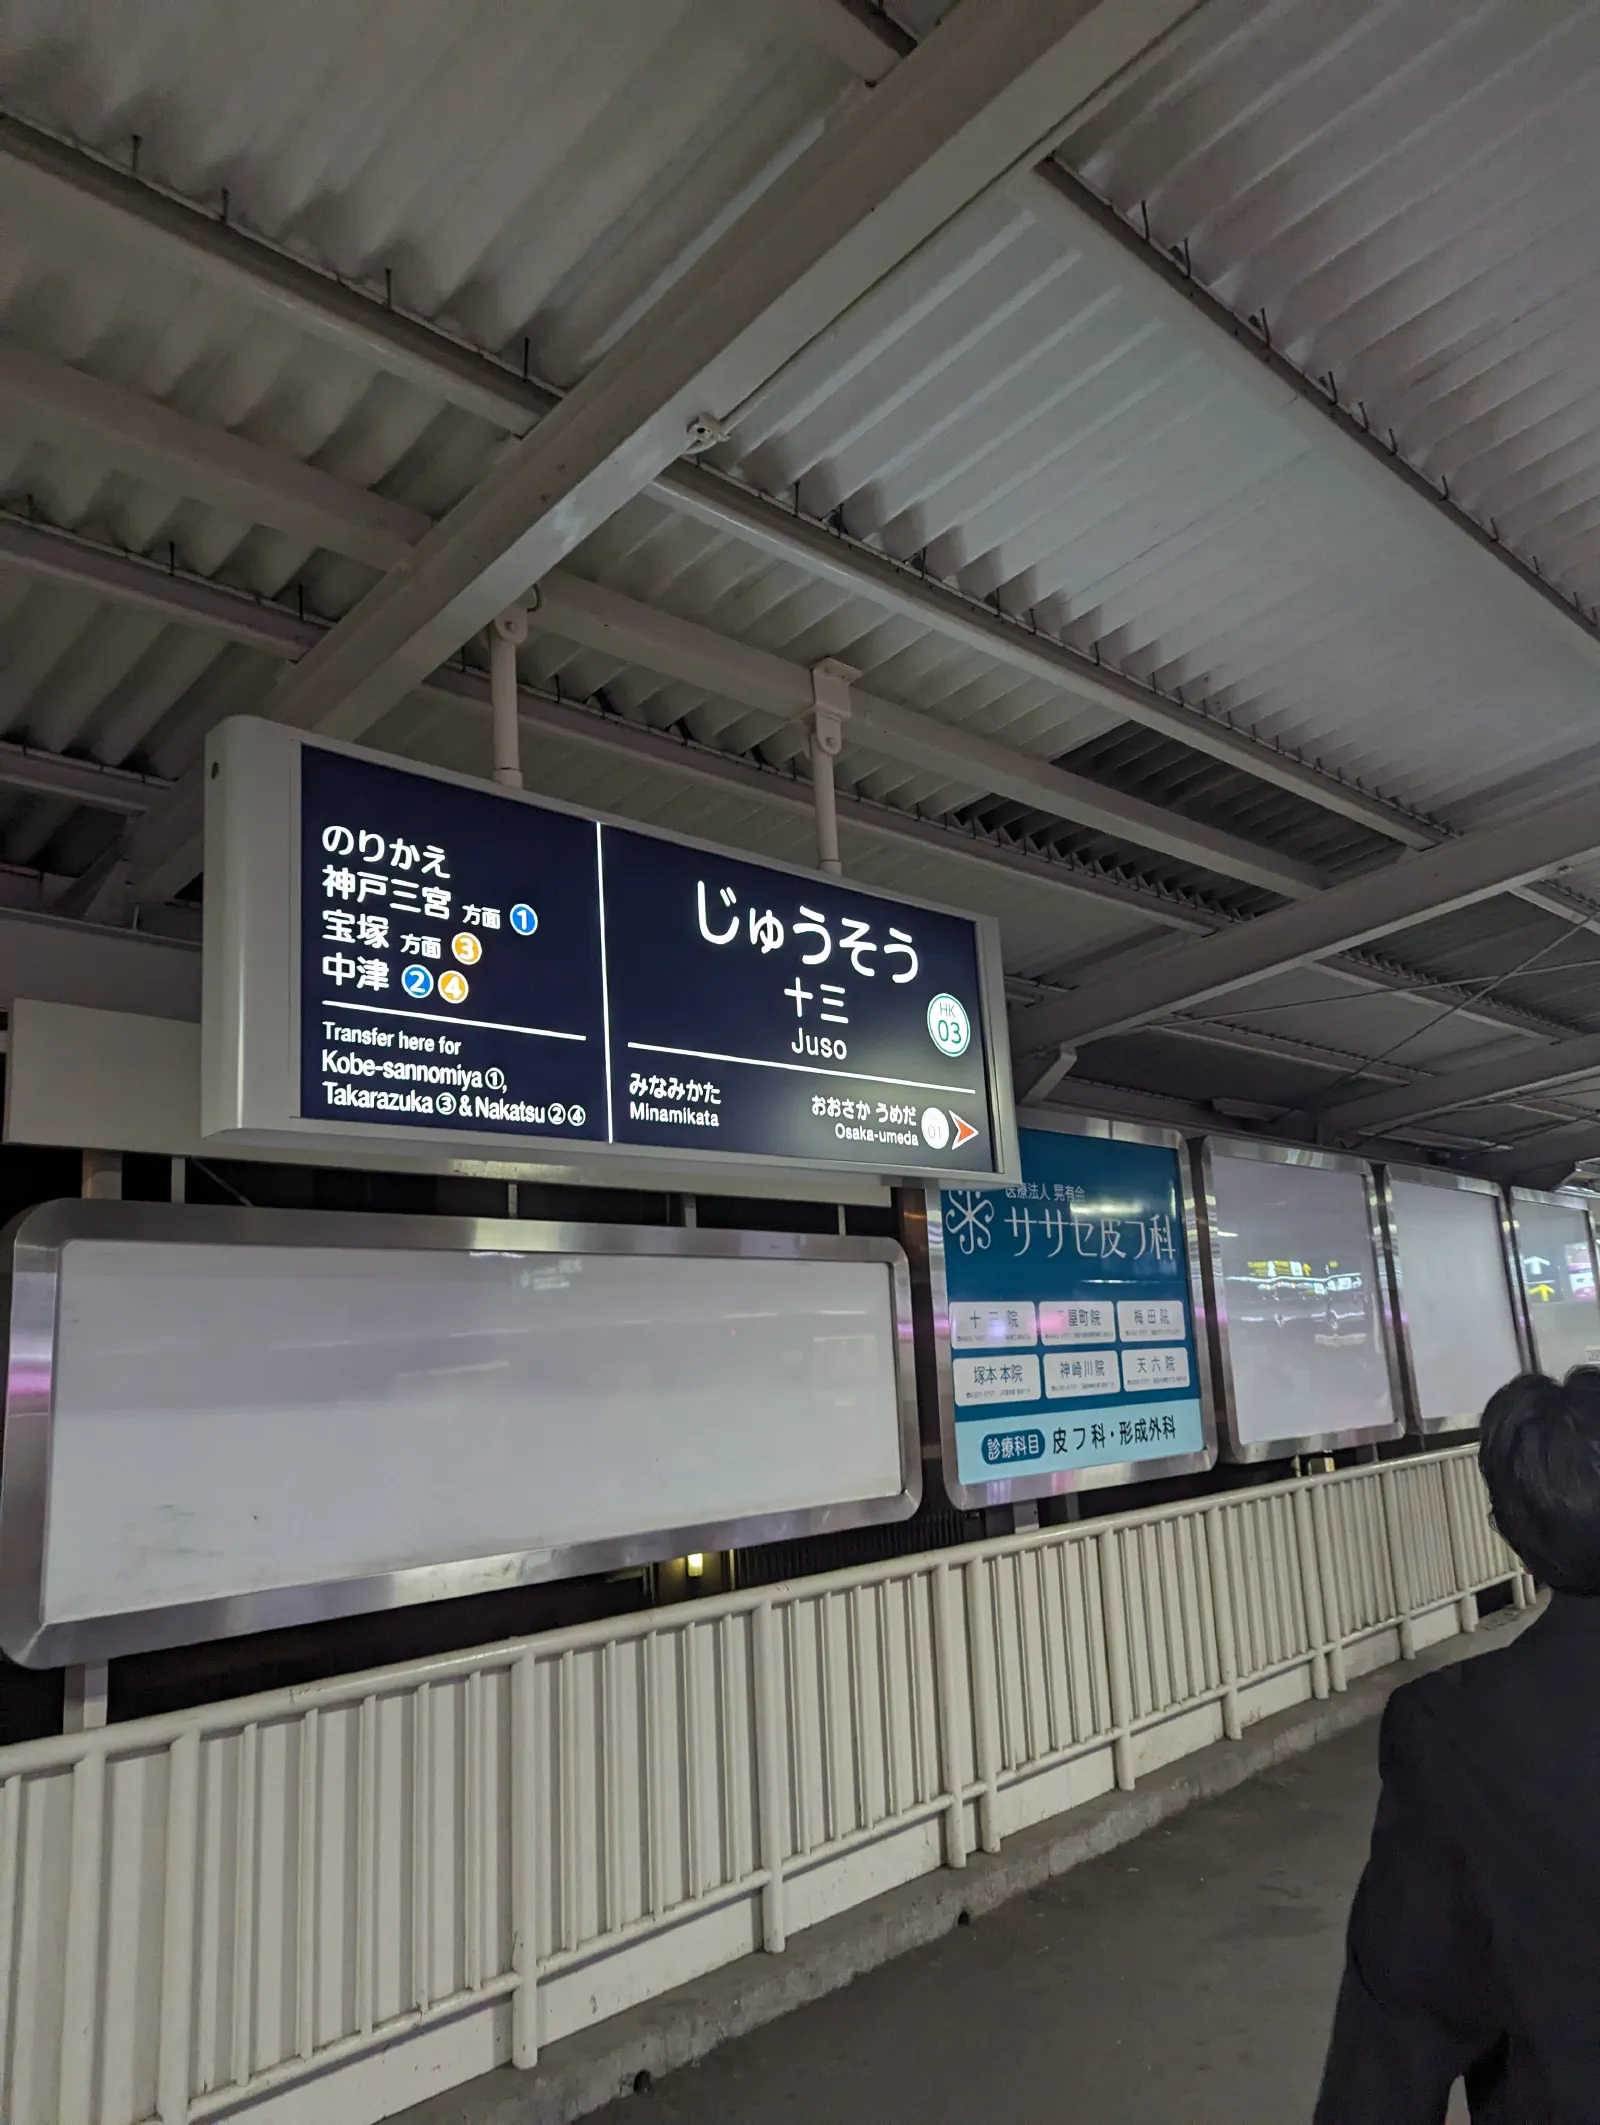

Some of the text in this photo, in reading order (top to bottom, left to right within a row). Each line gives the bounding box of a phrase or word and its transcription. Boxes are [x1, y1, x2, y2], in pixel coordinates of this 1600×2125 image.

[322, 825, 450, 879] のりかえ
[322, 865, 450, 920] 神戸三宮
[462, 904, 501, 930] 方面
[322, 909, 390, 949] 宝塚
[400, 933, 441, 959] 方面
[697, 880, 919, 984] じゅうそう
[322, 952, 390, 991] 中津
[783, 976, 849, 1024] 十三
[939, 1002, 956, 1018] HK
[322, 1021, 462, 1055] Transfer here for
[791, 1027, 848, 1060] Juso
[937, 1019, 962, 1044] 03
[322, 1049, 482, 1091] Kobe-sannomiya
[322, 1081, 433, 1114] Takarazuka
[459, 1096, 473, 1114] &
[475, 1096, 545, 1124] Nakatsu
[629, 1072, 722, 1105] みなみかた
[629, 1101, 720, 1128] Minamikata
[811, 1094, 871, 1121] おおさか
[875, 1102, 917, 1127] うめだ
[835, 1122, 919, 1147] Osaka-umeda
[987, 1434, 1040, 1461] 診療科目
